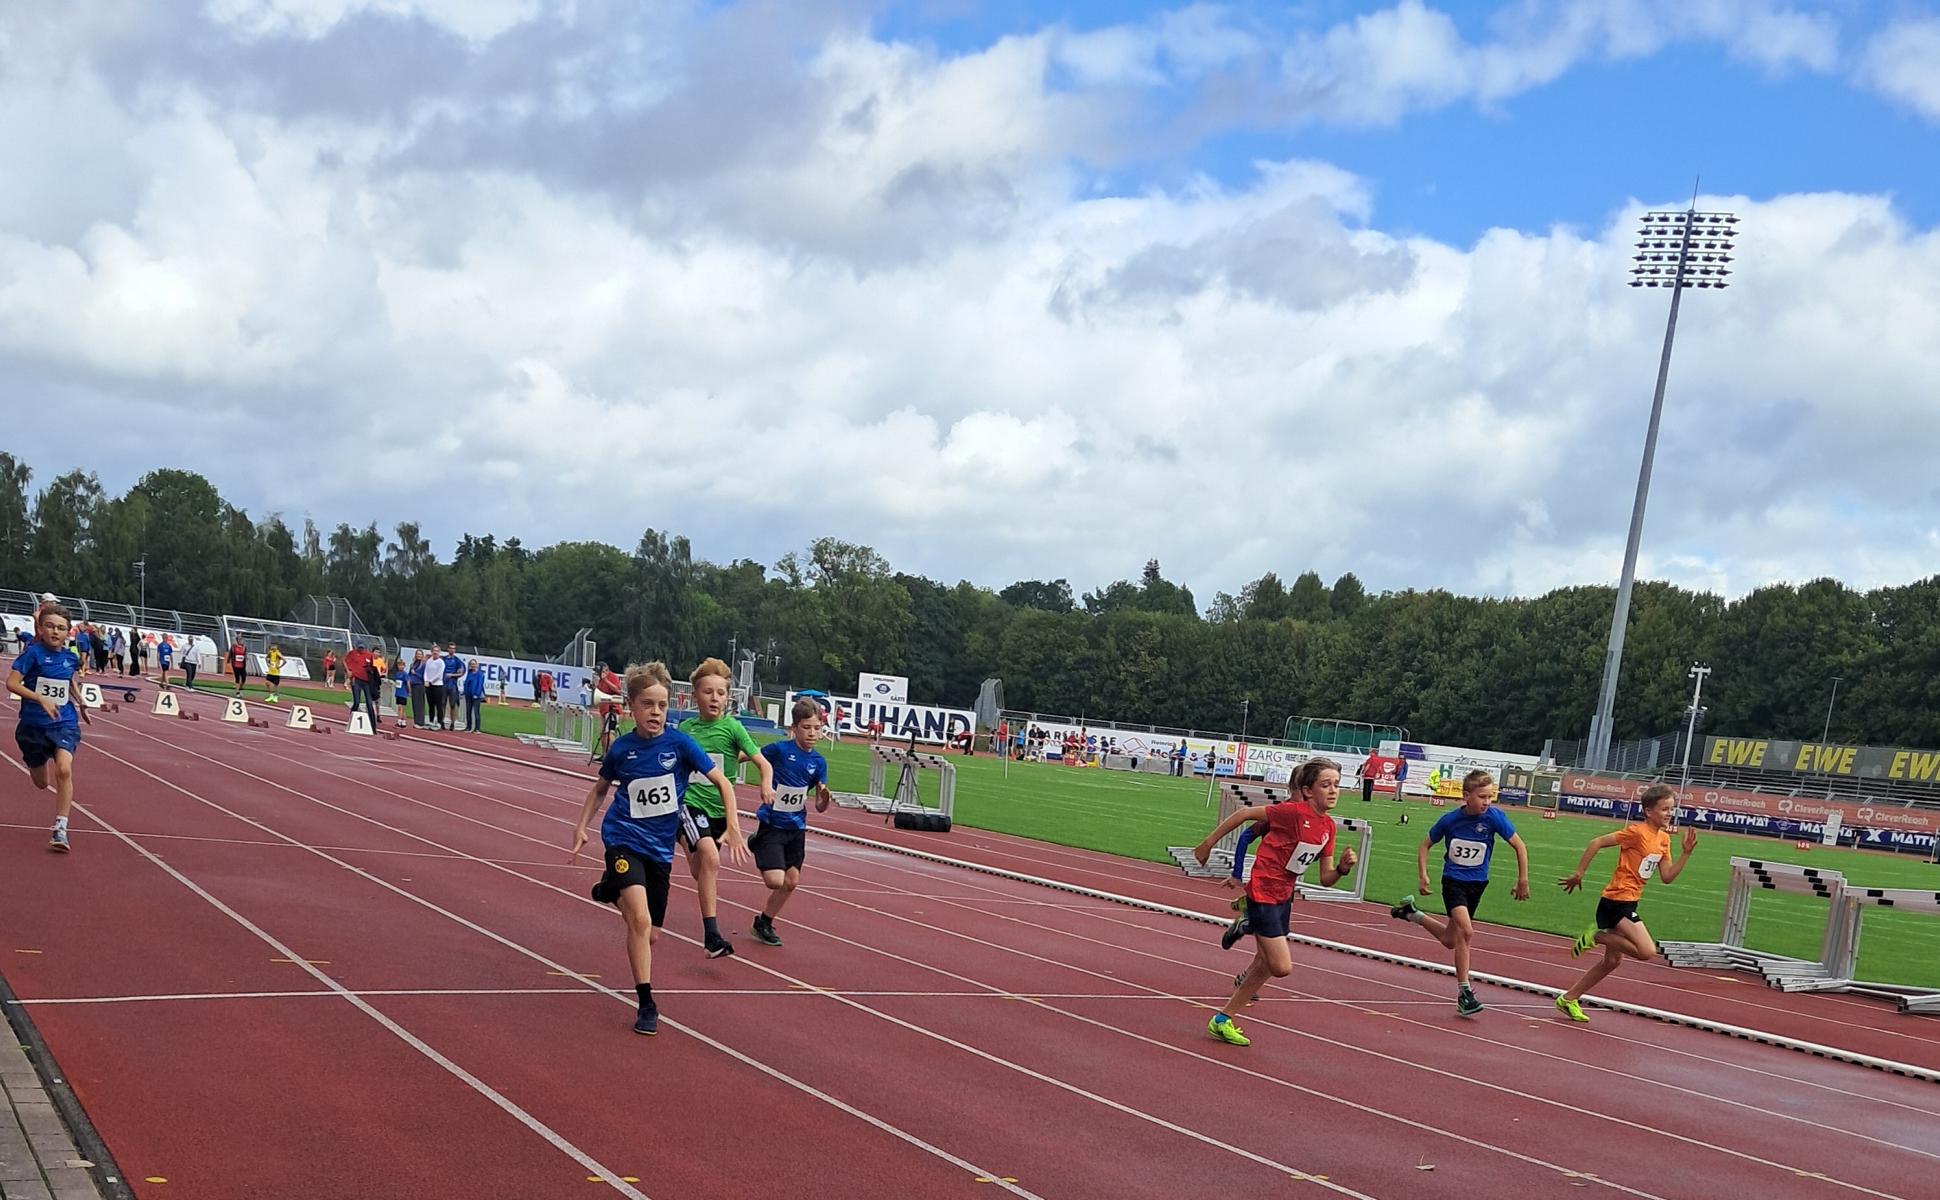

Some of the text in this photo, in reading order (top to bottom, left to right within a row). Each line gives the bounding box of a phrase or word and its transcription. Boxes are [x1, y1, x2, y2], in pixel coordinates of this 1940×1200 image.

[41, 684, 66, 698] 338
[85, 687, 97, 702] 5
[161, 694, 173, 709] 4
[232, 701, 243, 715] 3
[297, 708, 308, 722] 2
[357, 715, 363, 729] 1
[792, 695, 970, 742] EUHAND
[1248, 749, 1282, 762] ZARG
[1710, 739, 1940, 782] EWE EWE EW
[636, 786, 671, 806] 463
[780, 793, 804, 805] 461
[1454, 846, 1480, 859] 337
